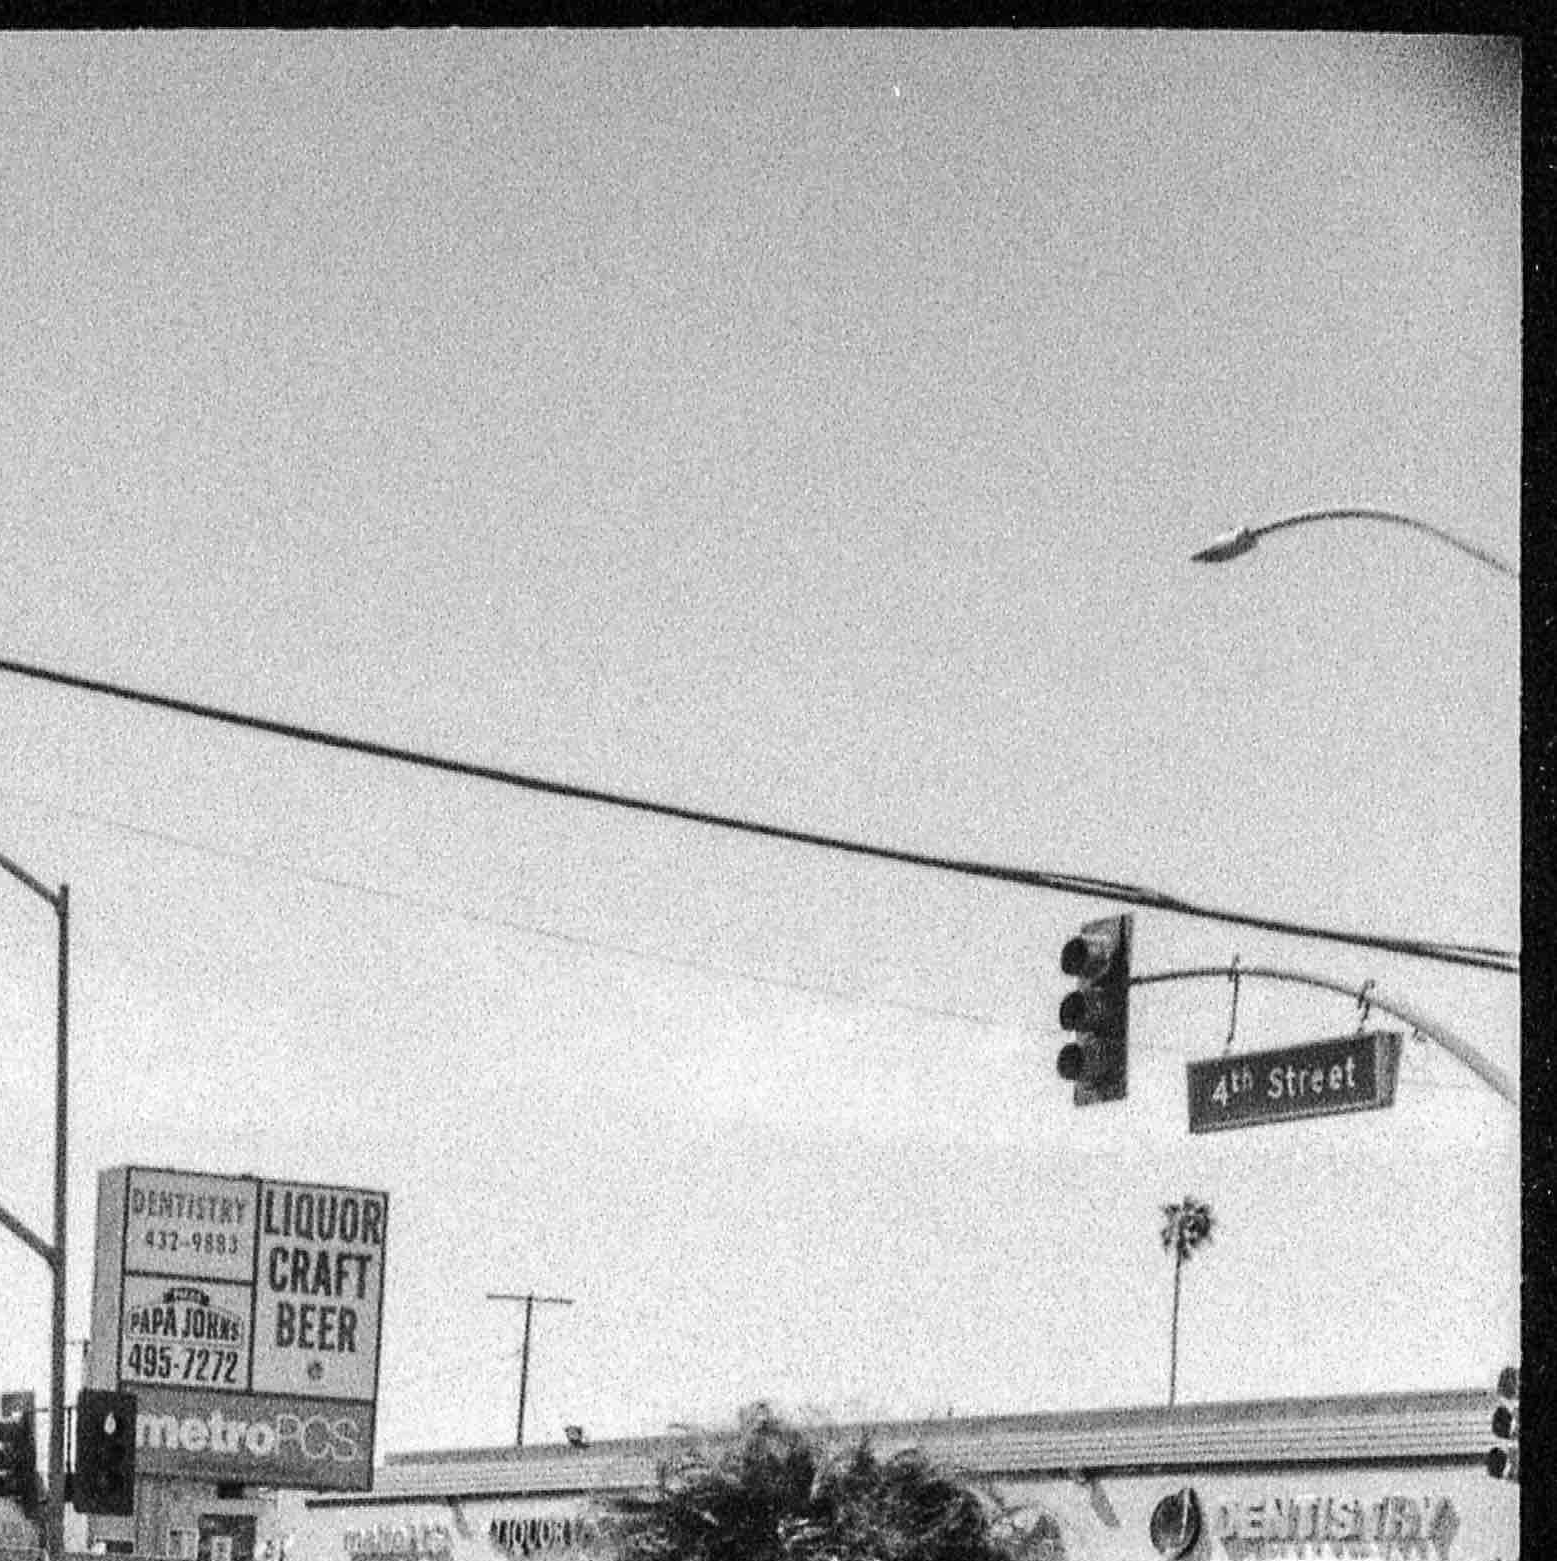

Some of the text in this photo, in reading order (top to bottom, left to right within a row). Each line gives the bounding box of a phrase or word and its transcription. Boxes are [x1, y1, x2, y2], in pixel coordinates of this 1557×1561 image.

[1212, 1055, 1356, 1107] 4th Street
[132, 1188, 246, 1224] DENTISTRY
[264, 1189, 382, 1245] LIQUOR
[268, 1246, 373, 1300] CRAFT
[130, 1306, 178, 1337] PAPA
[275, 1301, 358, 1352] BEER
[128, 1343, 239, 1384] 495-7272
